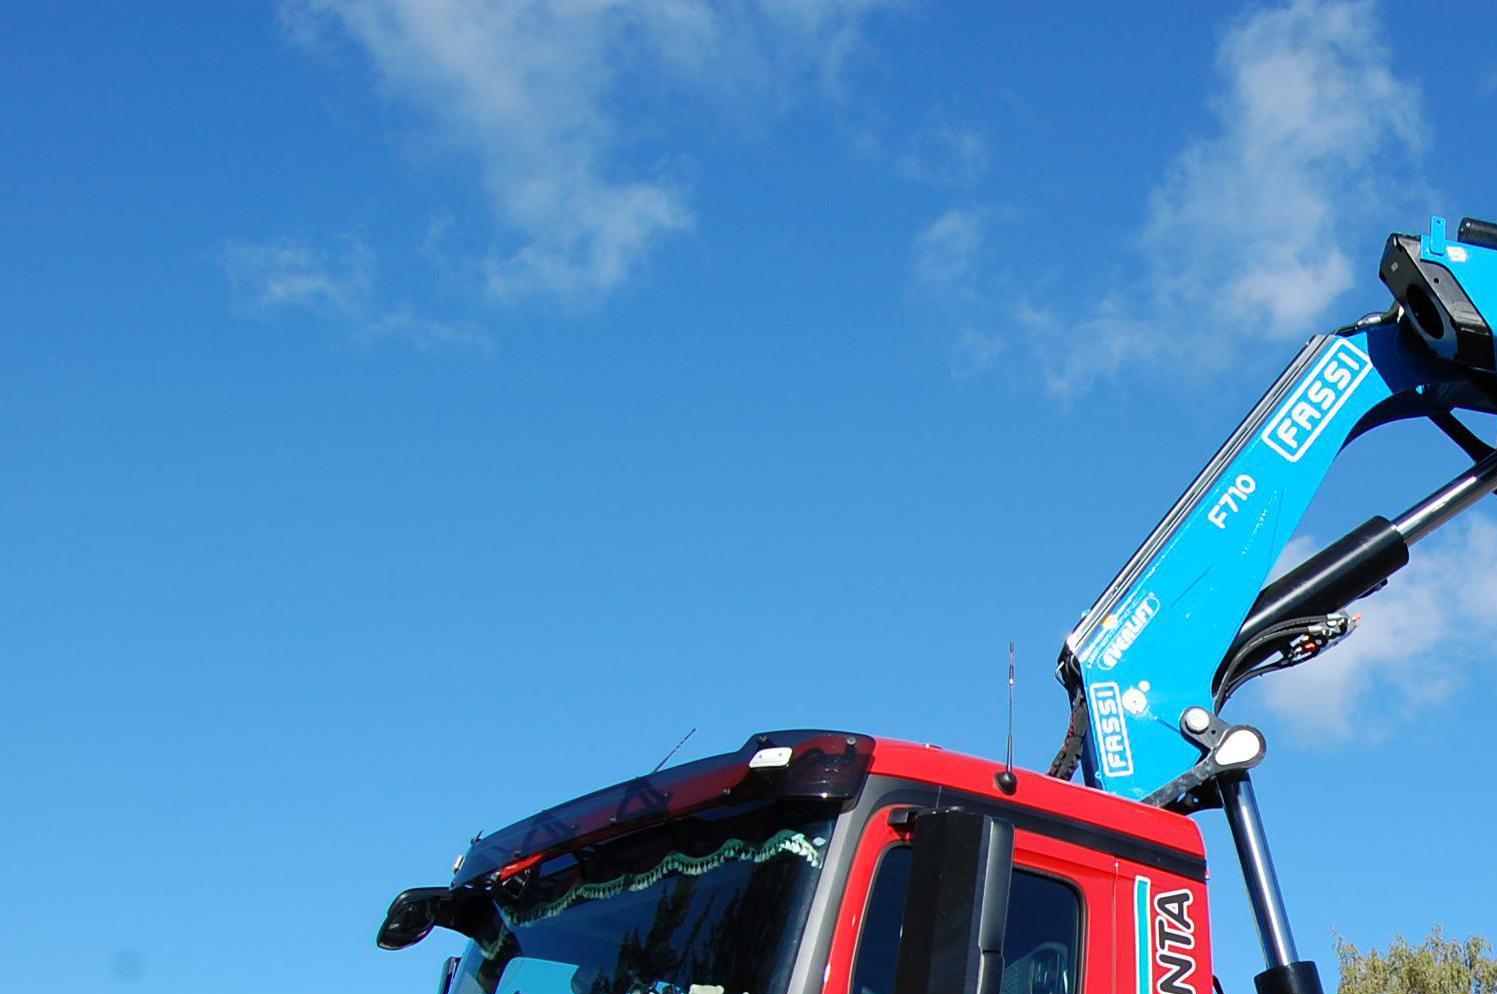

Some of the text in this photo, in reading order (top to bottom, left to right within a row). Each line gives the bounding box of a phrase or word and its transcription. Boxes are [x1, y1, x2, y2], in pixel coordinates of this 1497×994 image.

[1277, 352, 1361, 449] FASSI
[1207, 474, 1256, 529] F710
[1096, 690, 1127, 768] FASSI
